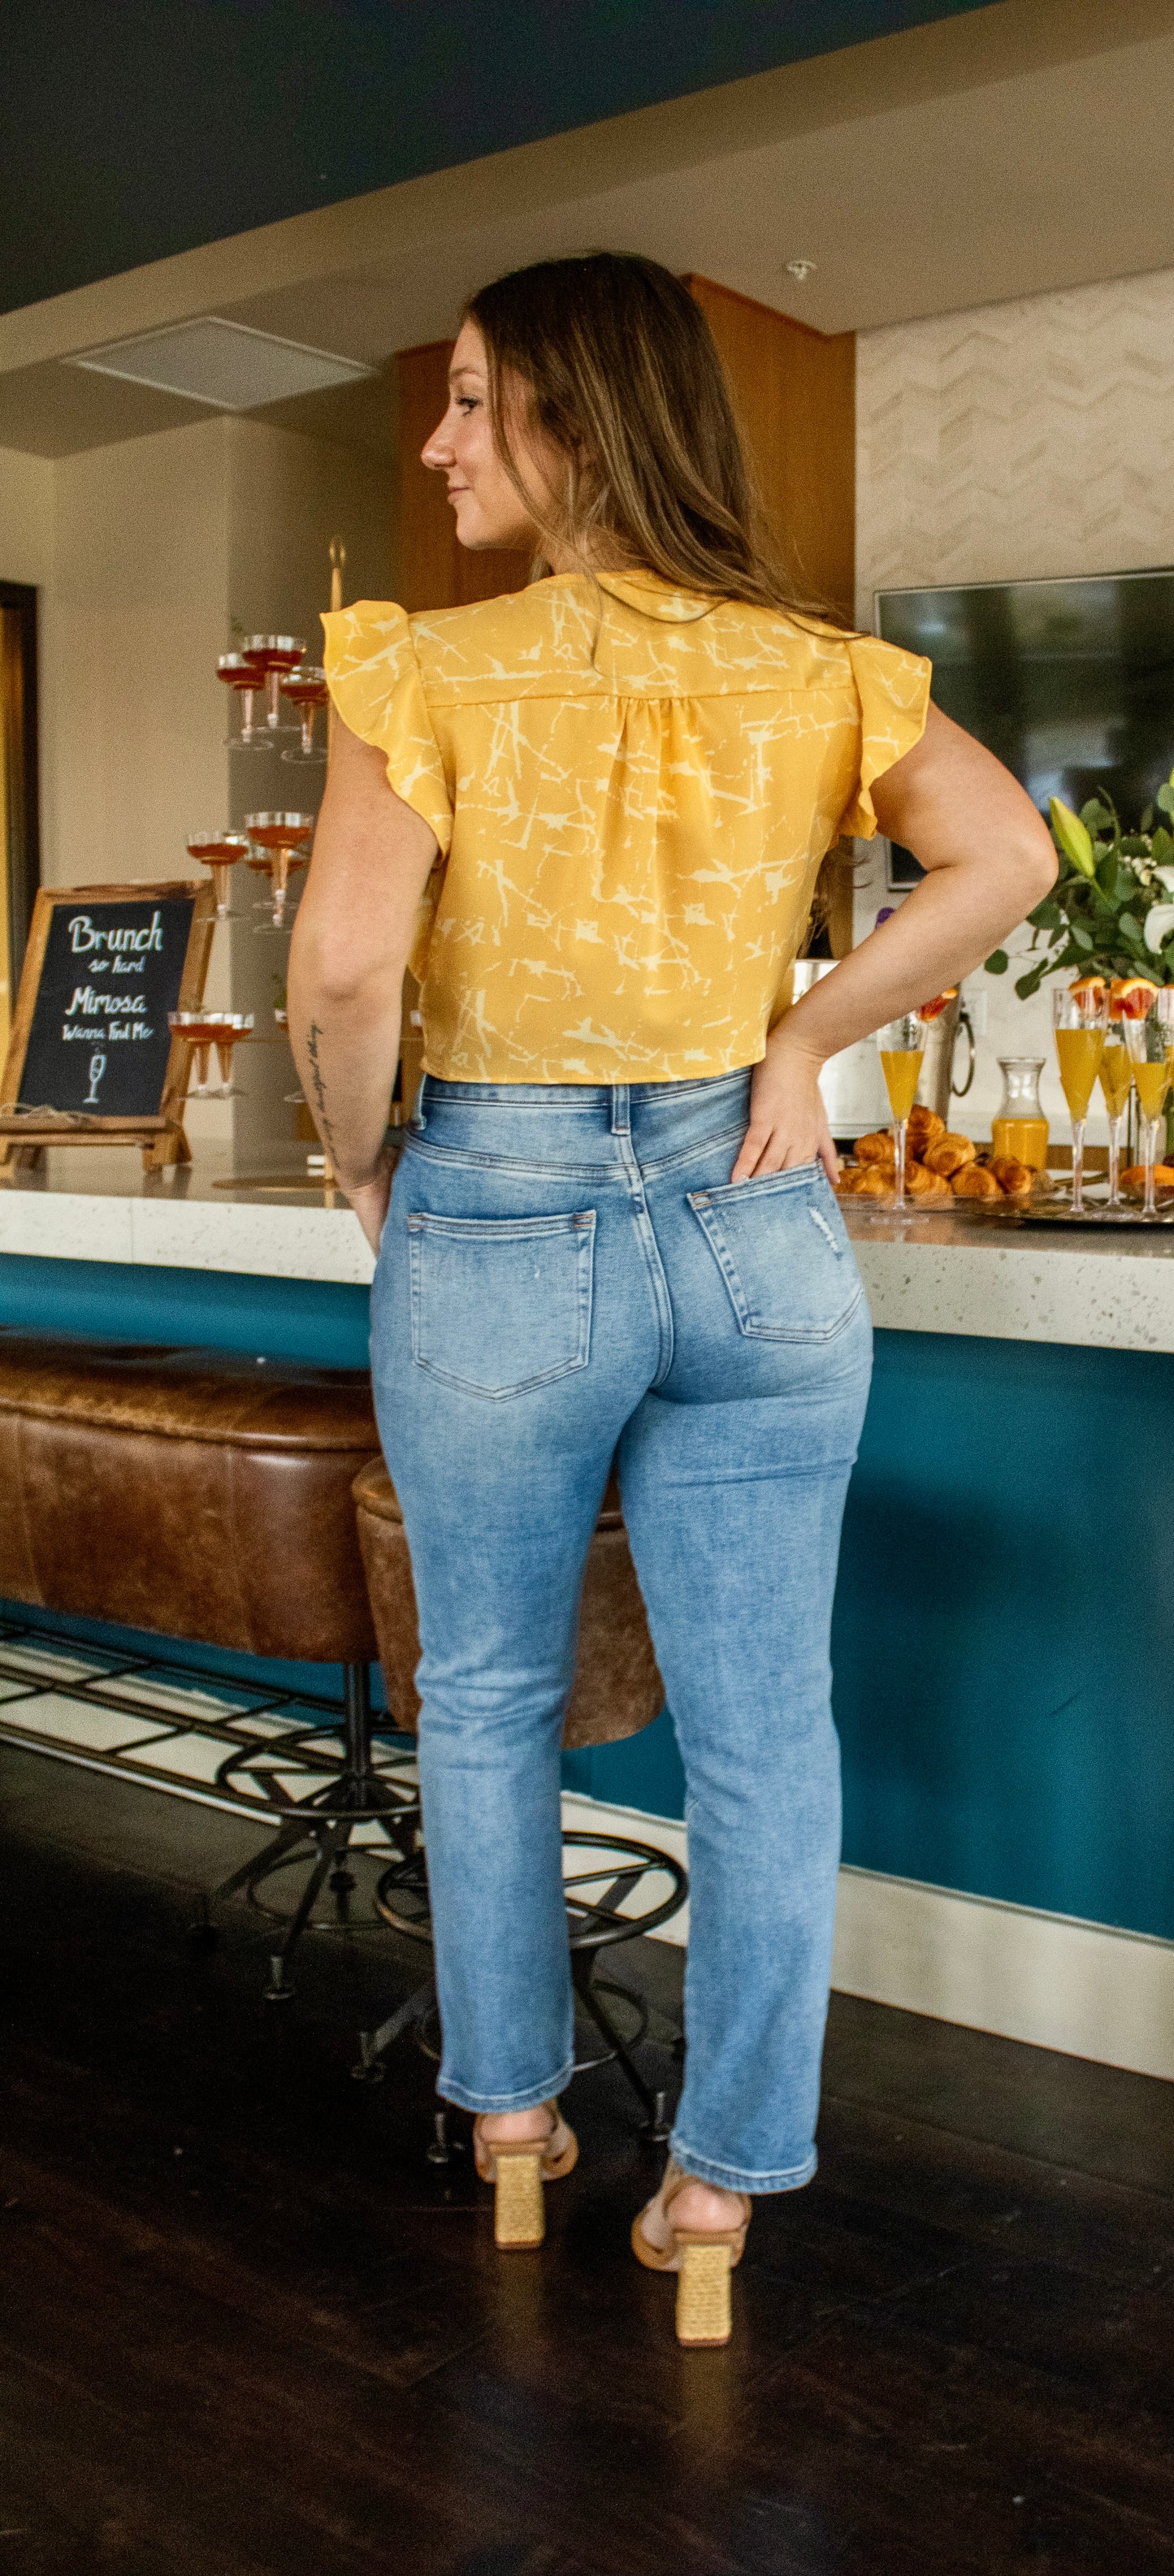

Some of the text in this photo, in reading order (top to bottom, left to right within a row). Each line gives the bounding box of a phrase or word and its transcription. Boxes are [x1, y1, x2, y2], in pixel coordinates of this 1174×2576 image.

[68, 910, 163, 954] Brunch
[88, 954, 147, 974] so hard
[64, 985, 148, 1015] Mimosa
[62, 1020, 154, 1041] Wanna Find Me
